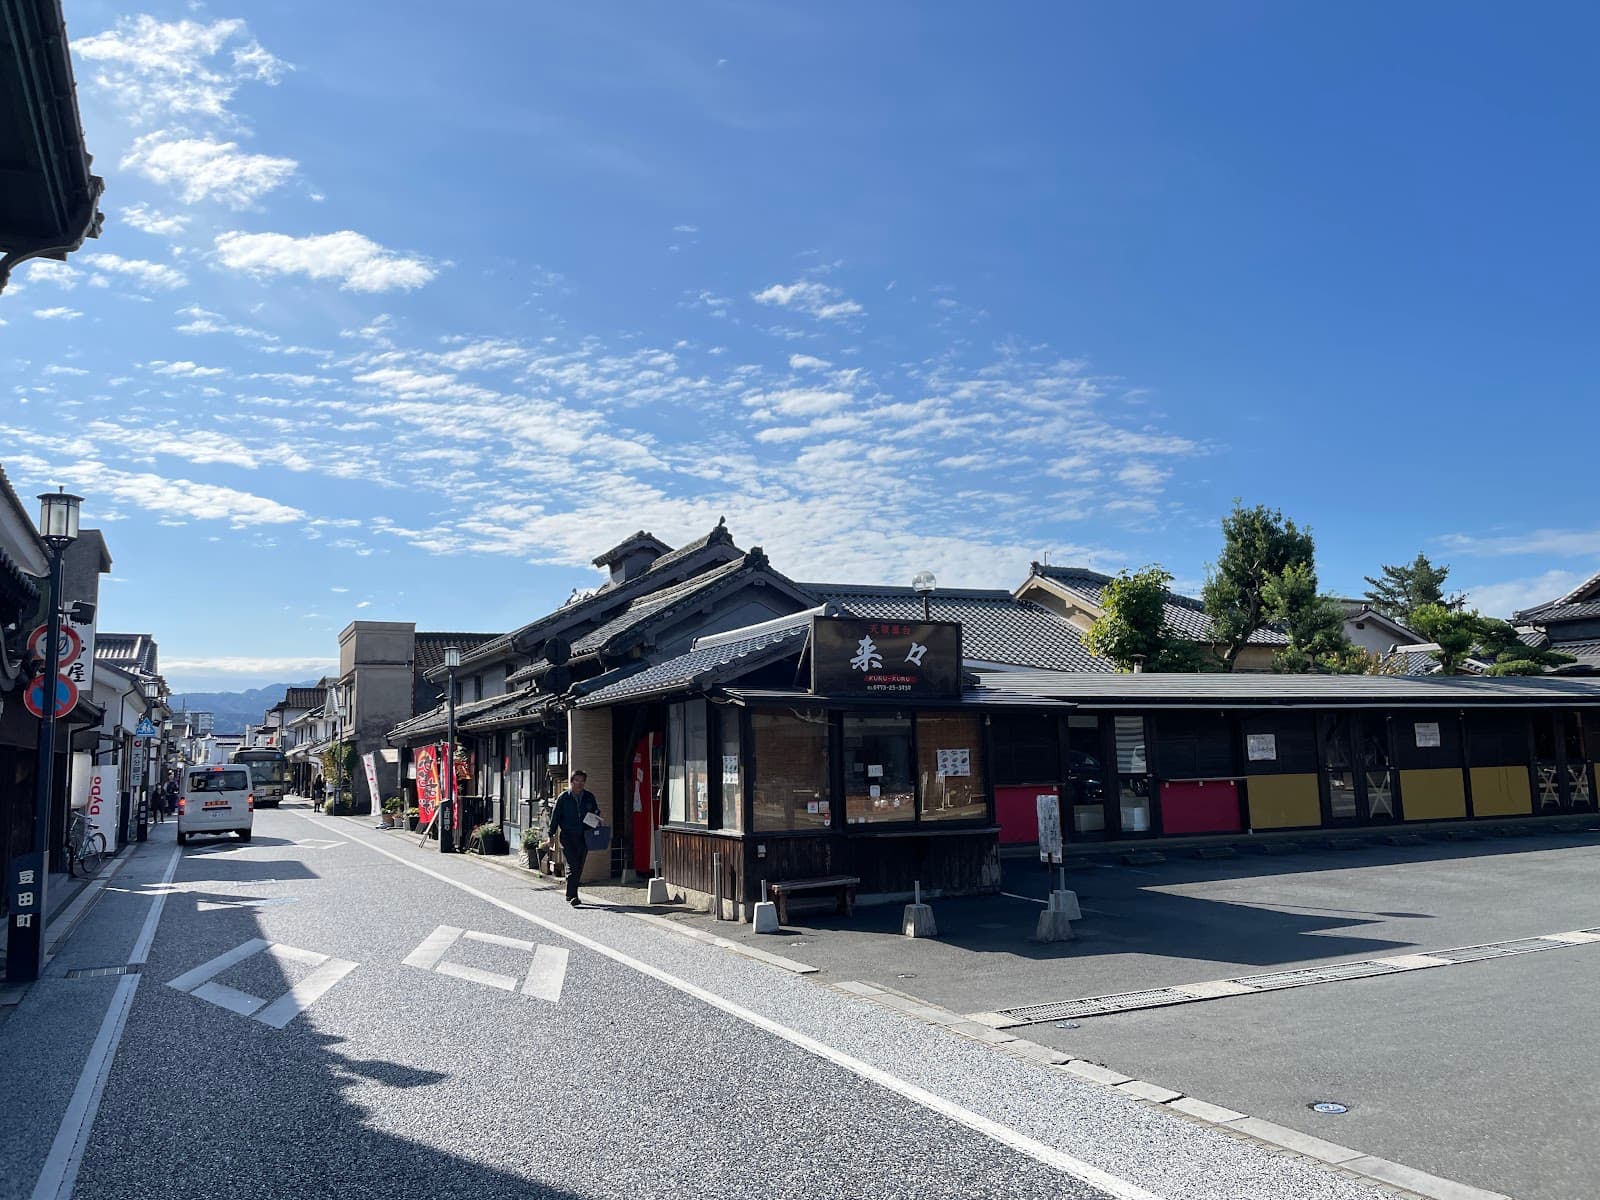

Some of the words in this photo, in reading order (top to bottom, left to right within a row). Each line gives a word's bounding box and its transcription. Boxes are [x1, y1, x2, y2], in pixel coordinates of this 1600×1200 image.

[849, 634, 928, 672] 来々
[90, 776, 104, 815] DyDo
[17, 869, 35, 928] 豆田町
